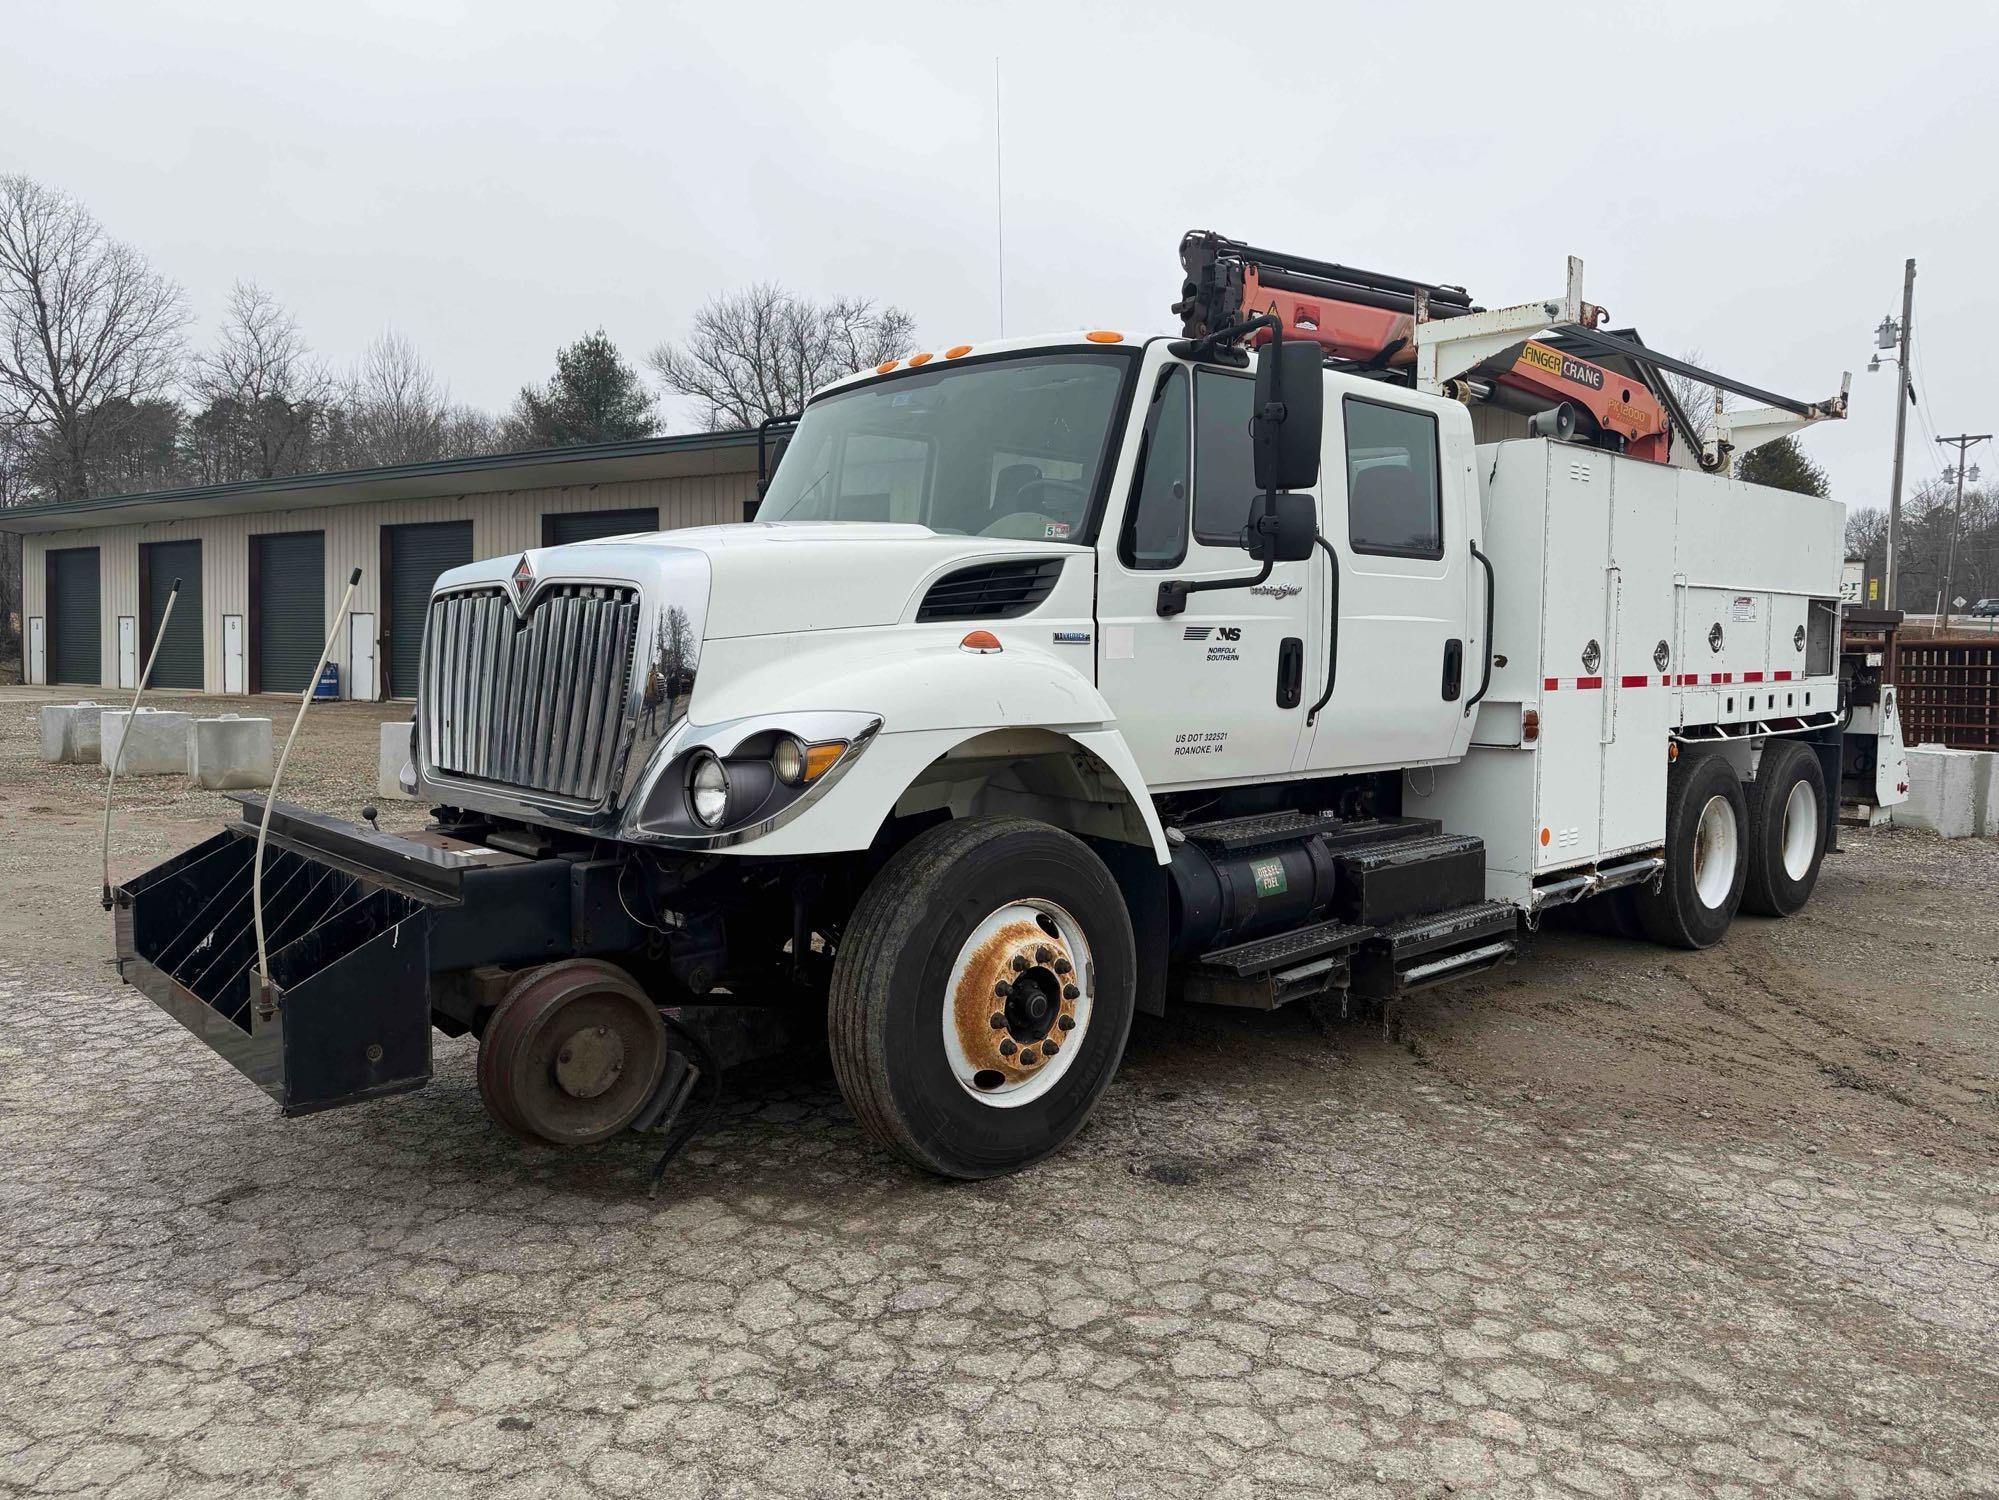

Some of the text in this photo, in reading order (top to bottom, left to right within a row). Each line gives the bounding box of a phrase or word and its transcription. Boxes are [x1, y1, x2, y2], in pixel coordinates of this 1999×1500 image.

[1563, 361, 1600, 387] CRANE
[1216, 627, 1241, 641] NS
[1175, 732, 1228, 743] US DOT 322521
[1174, 744, 1223, 755] ROANOKE, VA
[1258, 865, 1280, 877] DIESEL
[1263, 876, 1279, 889] FUEL
